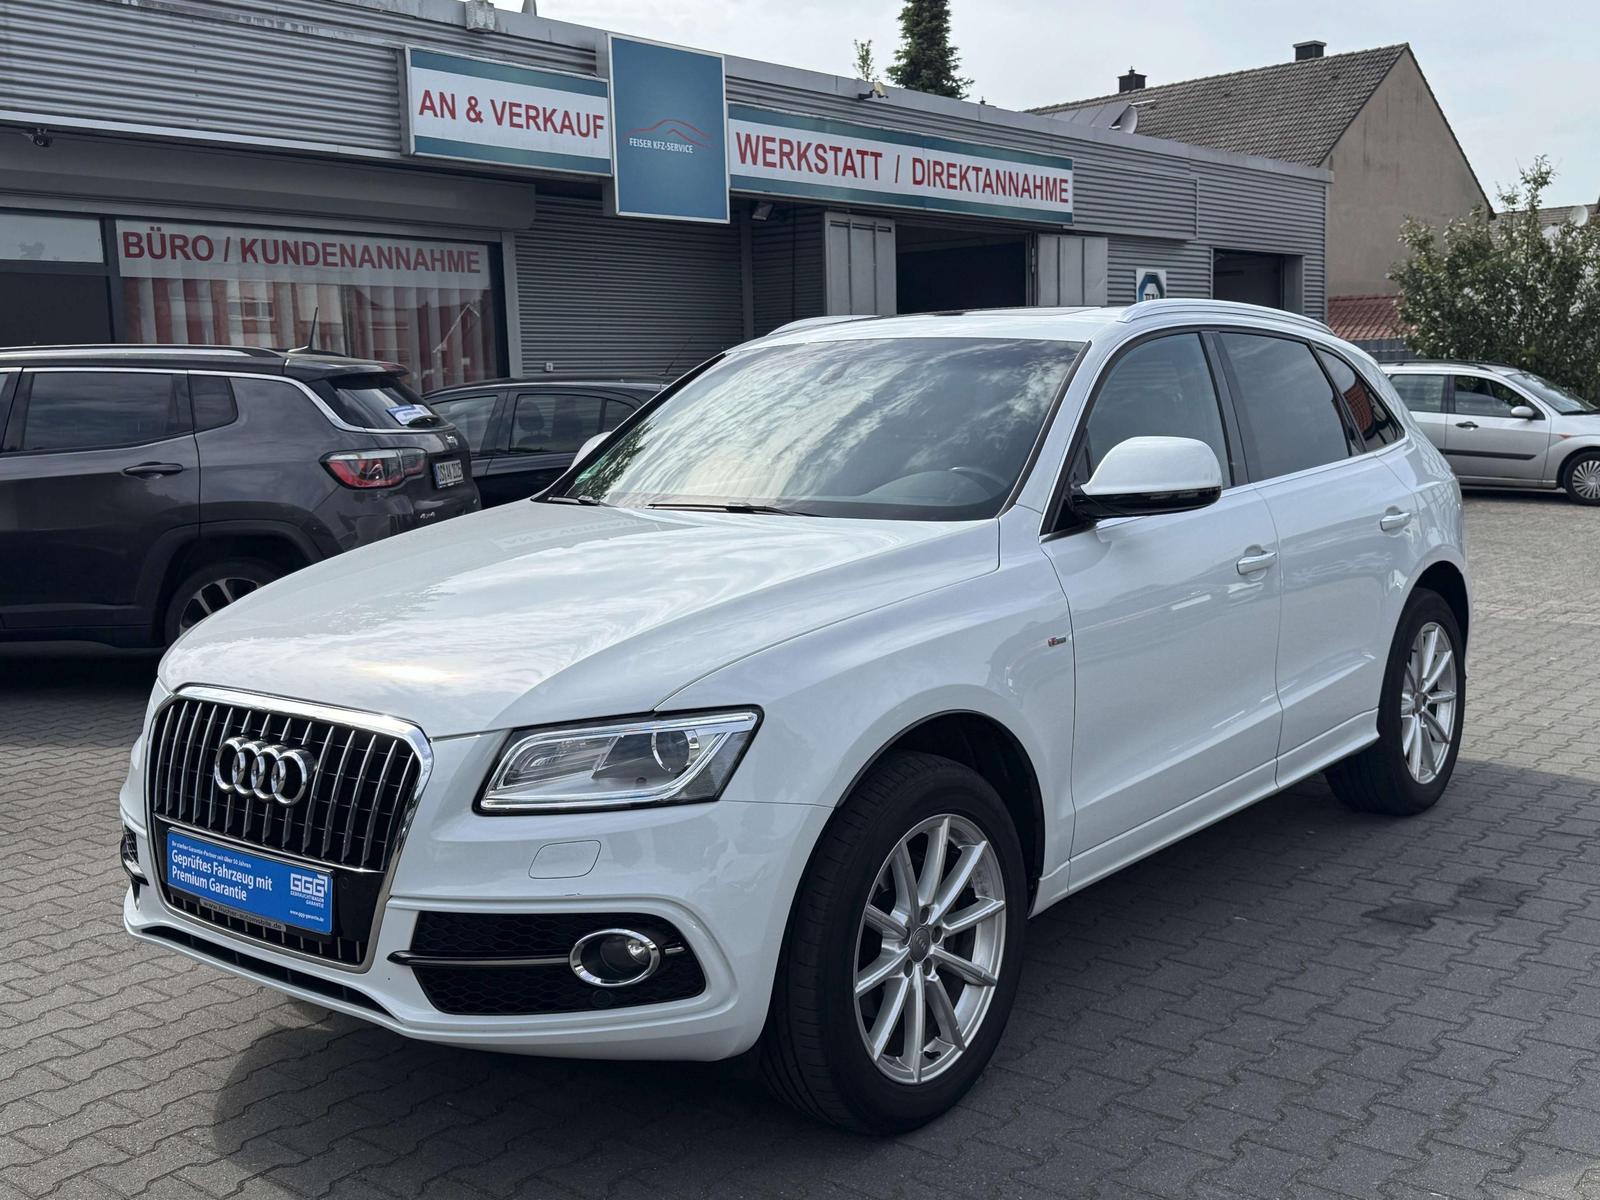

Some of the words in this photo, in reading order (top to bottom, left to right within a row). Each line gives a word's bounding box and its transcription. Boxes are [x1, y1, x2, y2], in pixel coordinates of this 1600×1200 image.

[419, 90, 457, 120] AN
[466, 96, 484, 123] &
[490, 99, 605, 139] VERKAUF
[629, 137, 652, 149] FEISER
[653, 139, 694, 153] KFZ-SERVICE
[736, 132, 883, 181] WERKSTATT
[895, 154, 901, 184] /
[912, 157, 1069, 204] DIREKTANNAHME
[122, 226, 215, 263] BÜRO
[224, 236, 231, 263] /
[240, 237, 481, 274] KUNDENANNAHME
[172, 850, 212, 874] Geprüftes
[213, 862, 254, 890] Fahrzeug
[256, 875, 273, 892] mit
[172, 865, 208, 889] Premium
[209, 880, 247, 901] Garantie
[290, 873, 324, 897] GGG
